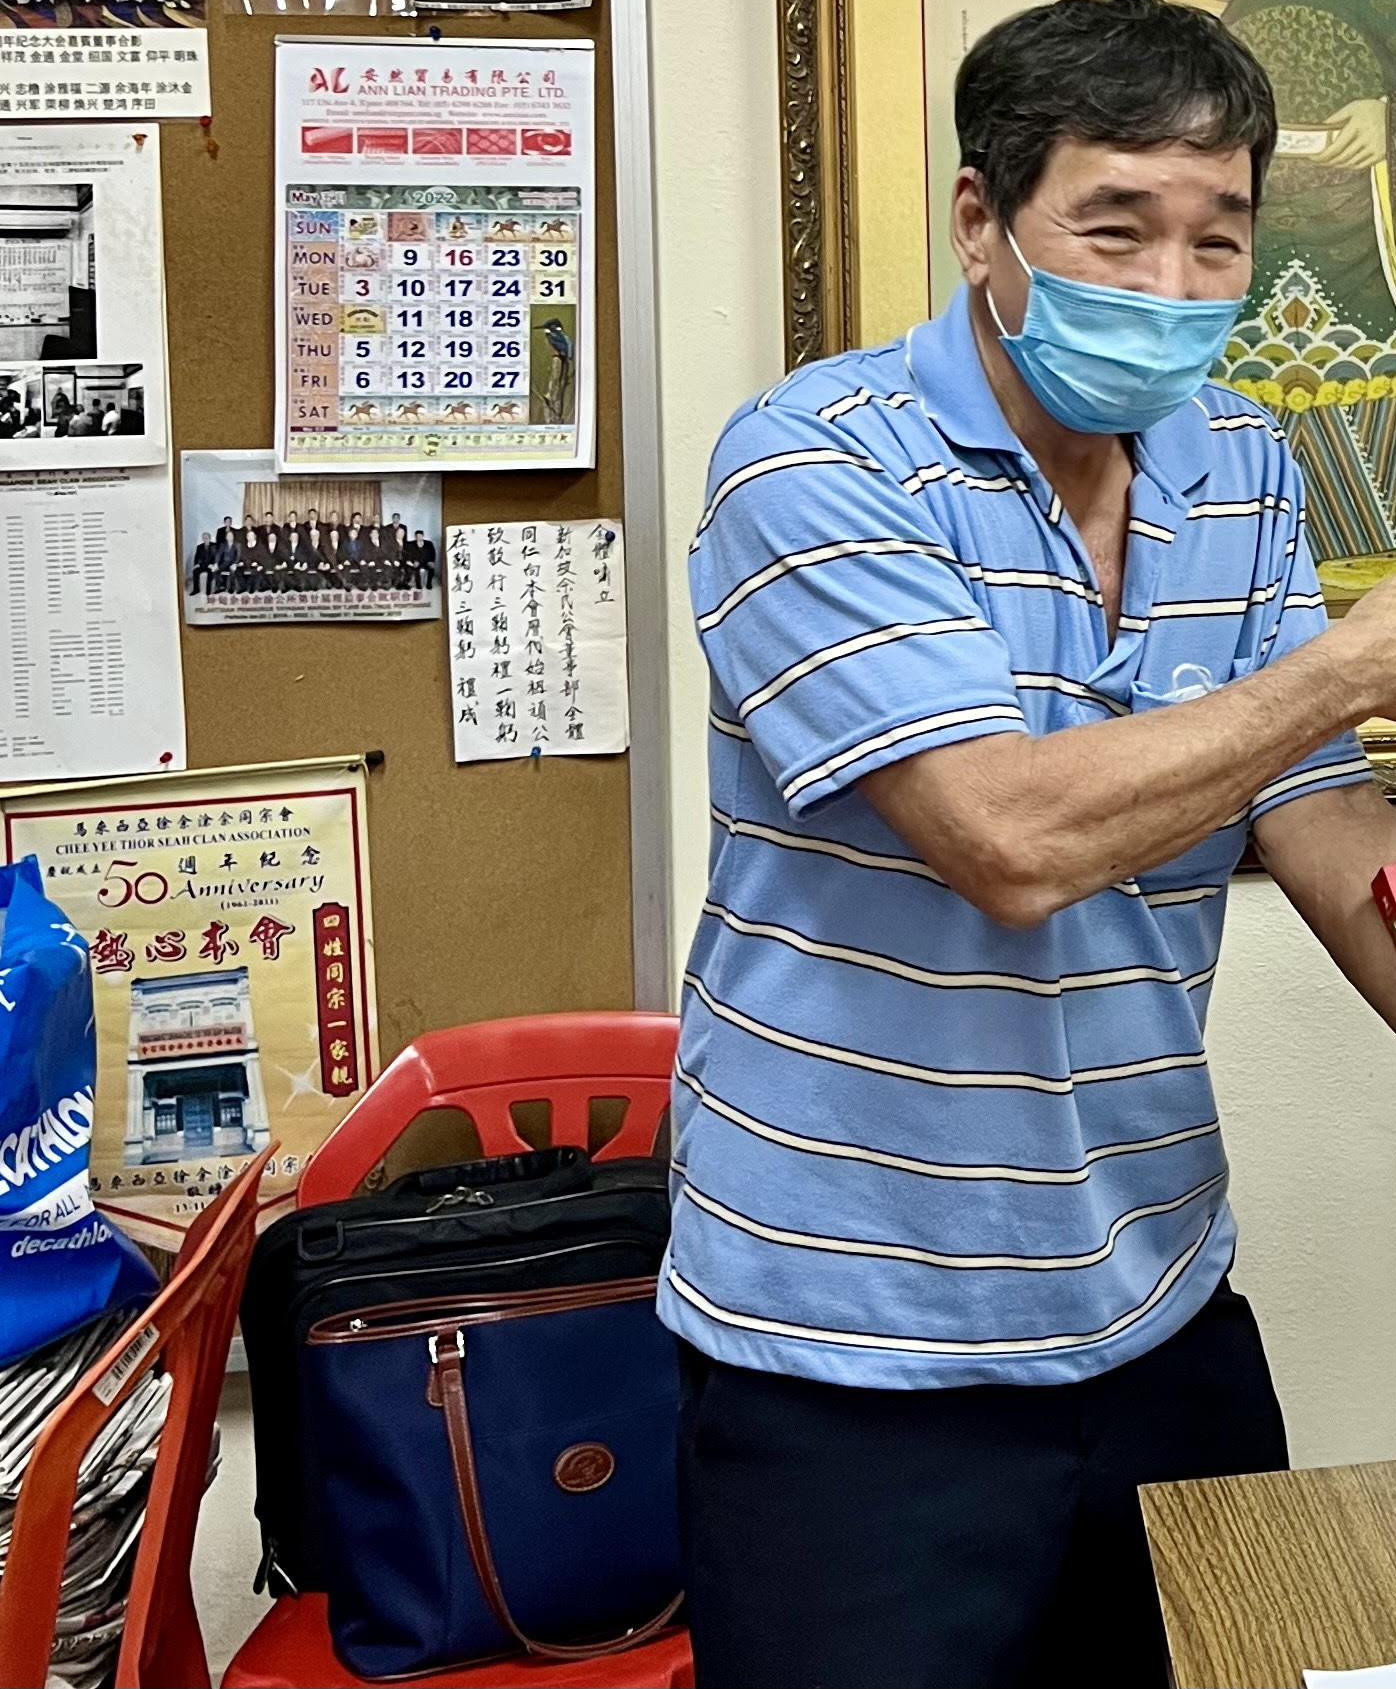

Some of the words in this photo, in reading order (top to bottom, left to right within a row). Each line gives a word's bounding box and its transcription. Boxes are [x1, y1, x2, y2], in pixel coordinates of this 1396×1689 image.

[357, 85, 388, 96] ANN
[394, 86, 426, 97] LIAN
[430, 86, 497, 98] TRADING
[292, 191, 318, 206] May
[415, 191, 456, 204] 2022
[296, 221, 332, 235] SUN
[293, 251, 335, 265] MON
[403, 249, 418, 266] 9
[445, 249, 473, 266] 16
[491, 249, 521, 266] 23
[539, 249, 568, 266] 30
[298, 282, 330, 296] TUE
[355, 280, 370, 297] 3
[397, 280, 425, 297] 10
[445, 280, 473, 297] 17
[491, 280, 521, 297] 24
[539, 280, 566, 297] 31
[296, 313, 333, 326] WED
[397, 310, 424, 327] 11
[445, 310, 473, 327] 18
[491, 310, 521, 327] 25
[297, 344, 332, 357] THU
[356, 341, 371, 358] 5
[397, 341, 425, 358] 12
[445, 341, 473, 358] 19
[491, 341, 521, 358] 26
[301, 375, 328, 389] FRI
[355, 371, 370, 389] 6
[397, 371, 425, 389] 13
[444, 371, 473, 389] 20
[491, 371, 520, 389] 27
[298, 406, 330, 419] SAT
[55, 841, 92, 855] CHEE
[92, 840, 117, 853] YEE
[120, 839, 155, 851] THOR
[193, 833, 226, 845] CLAN
[228, 827, 312, 843] ASSOCIATION
[97, 859, 169, 908] 50
[171, 871, 326, 900] Anniversary
[55, 1194, 81, 1222] ALL
